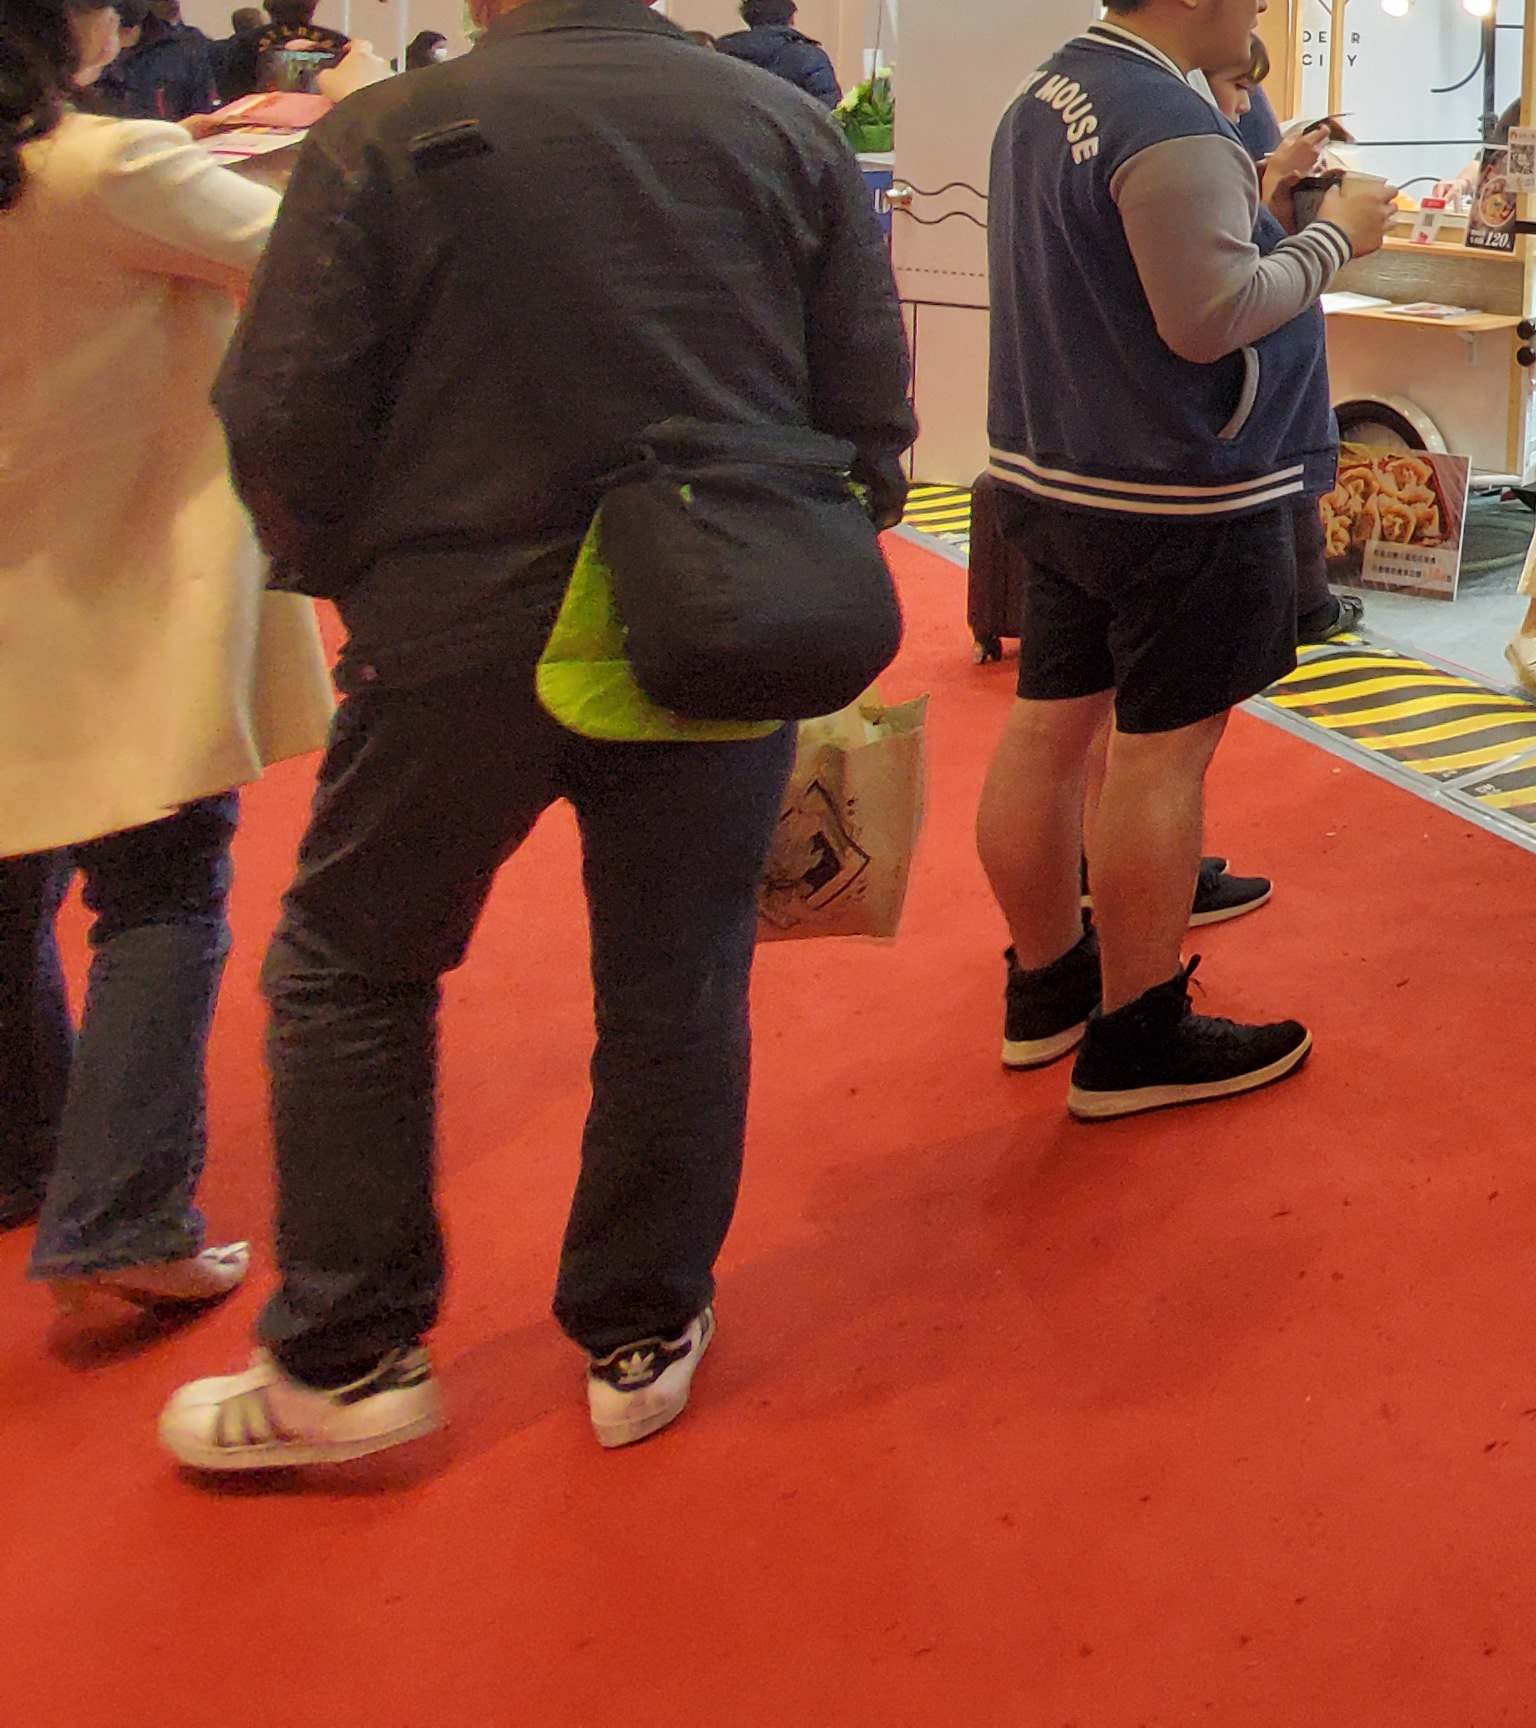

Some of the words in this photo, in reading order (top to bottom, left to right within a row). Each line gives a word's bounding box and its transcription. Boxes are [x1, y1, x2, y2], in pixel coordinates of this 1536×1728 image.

[1302, 30, 1361, 44] DER
[1302, 53, 1358, 67] CIY
[1034, 74, 1100, 165] MOUSE
[1485, 231, 1508, 248] 120
